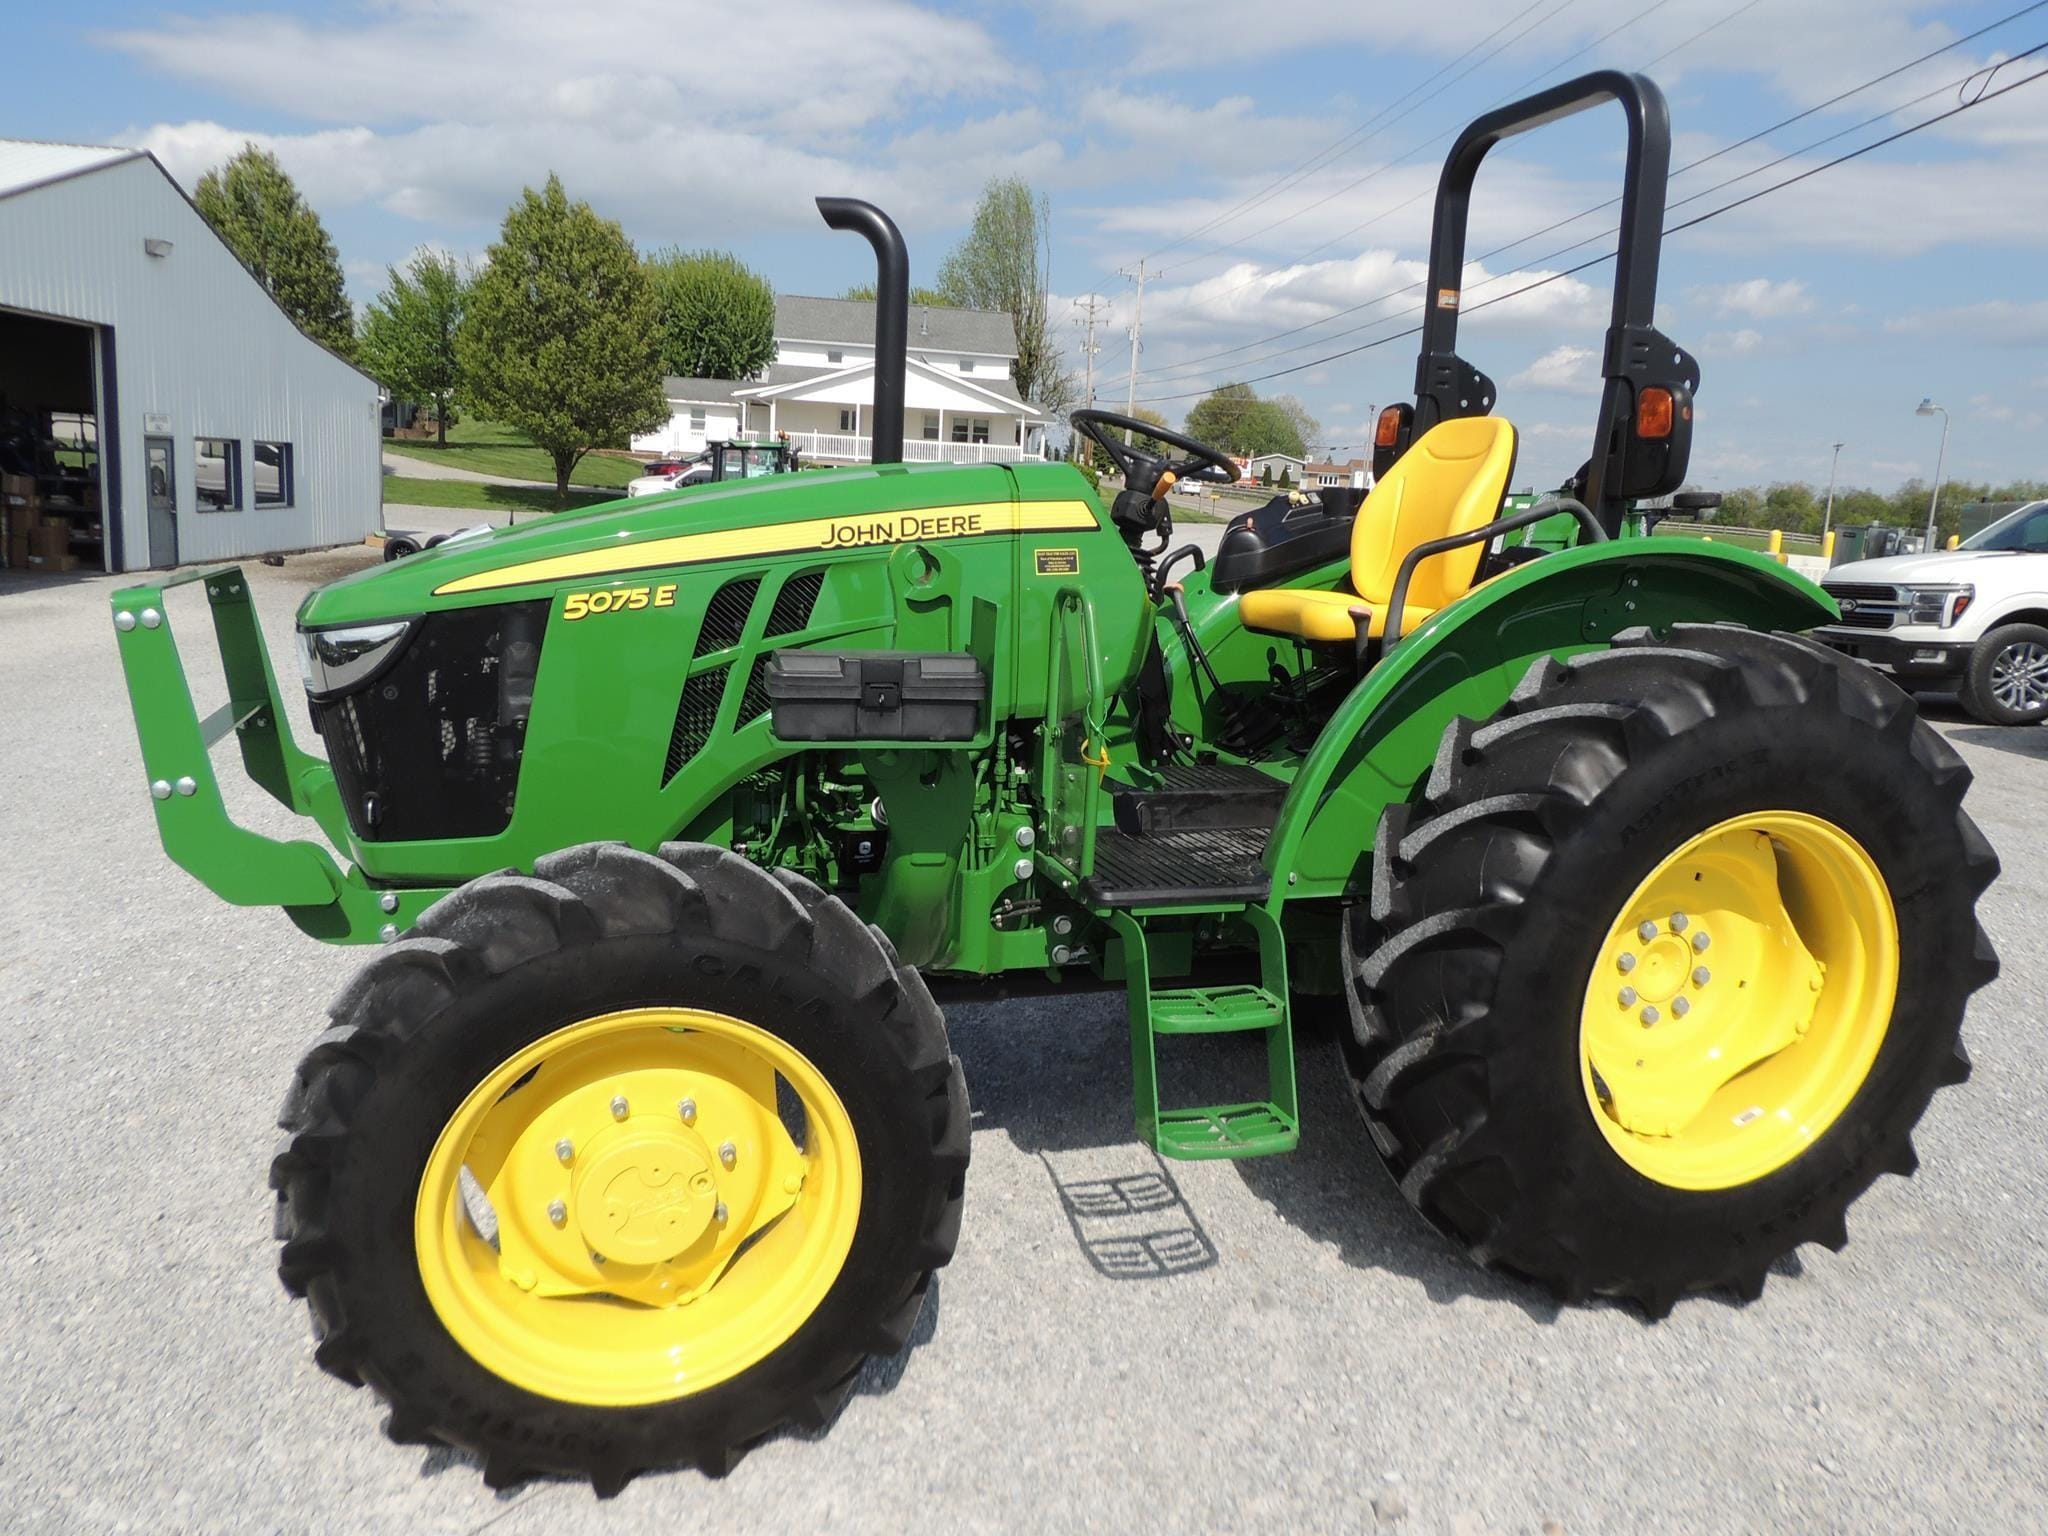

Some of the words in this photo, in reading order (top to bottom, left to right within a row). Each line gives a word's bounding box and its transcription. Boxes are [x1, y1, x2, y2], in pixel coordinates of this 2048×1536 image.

[821, 522, 893, 545] JOHN
[900, 514, 982, 538] DEERE
[563, 587, 651, 621] 5075
[654, 584, 679, 608] E
